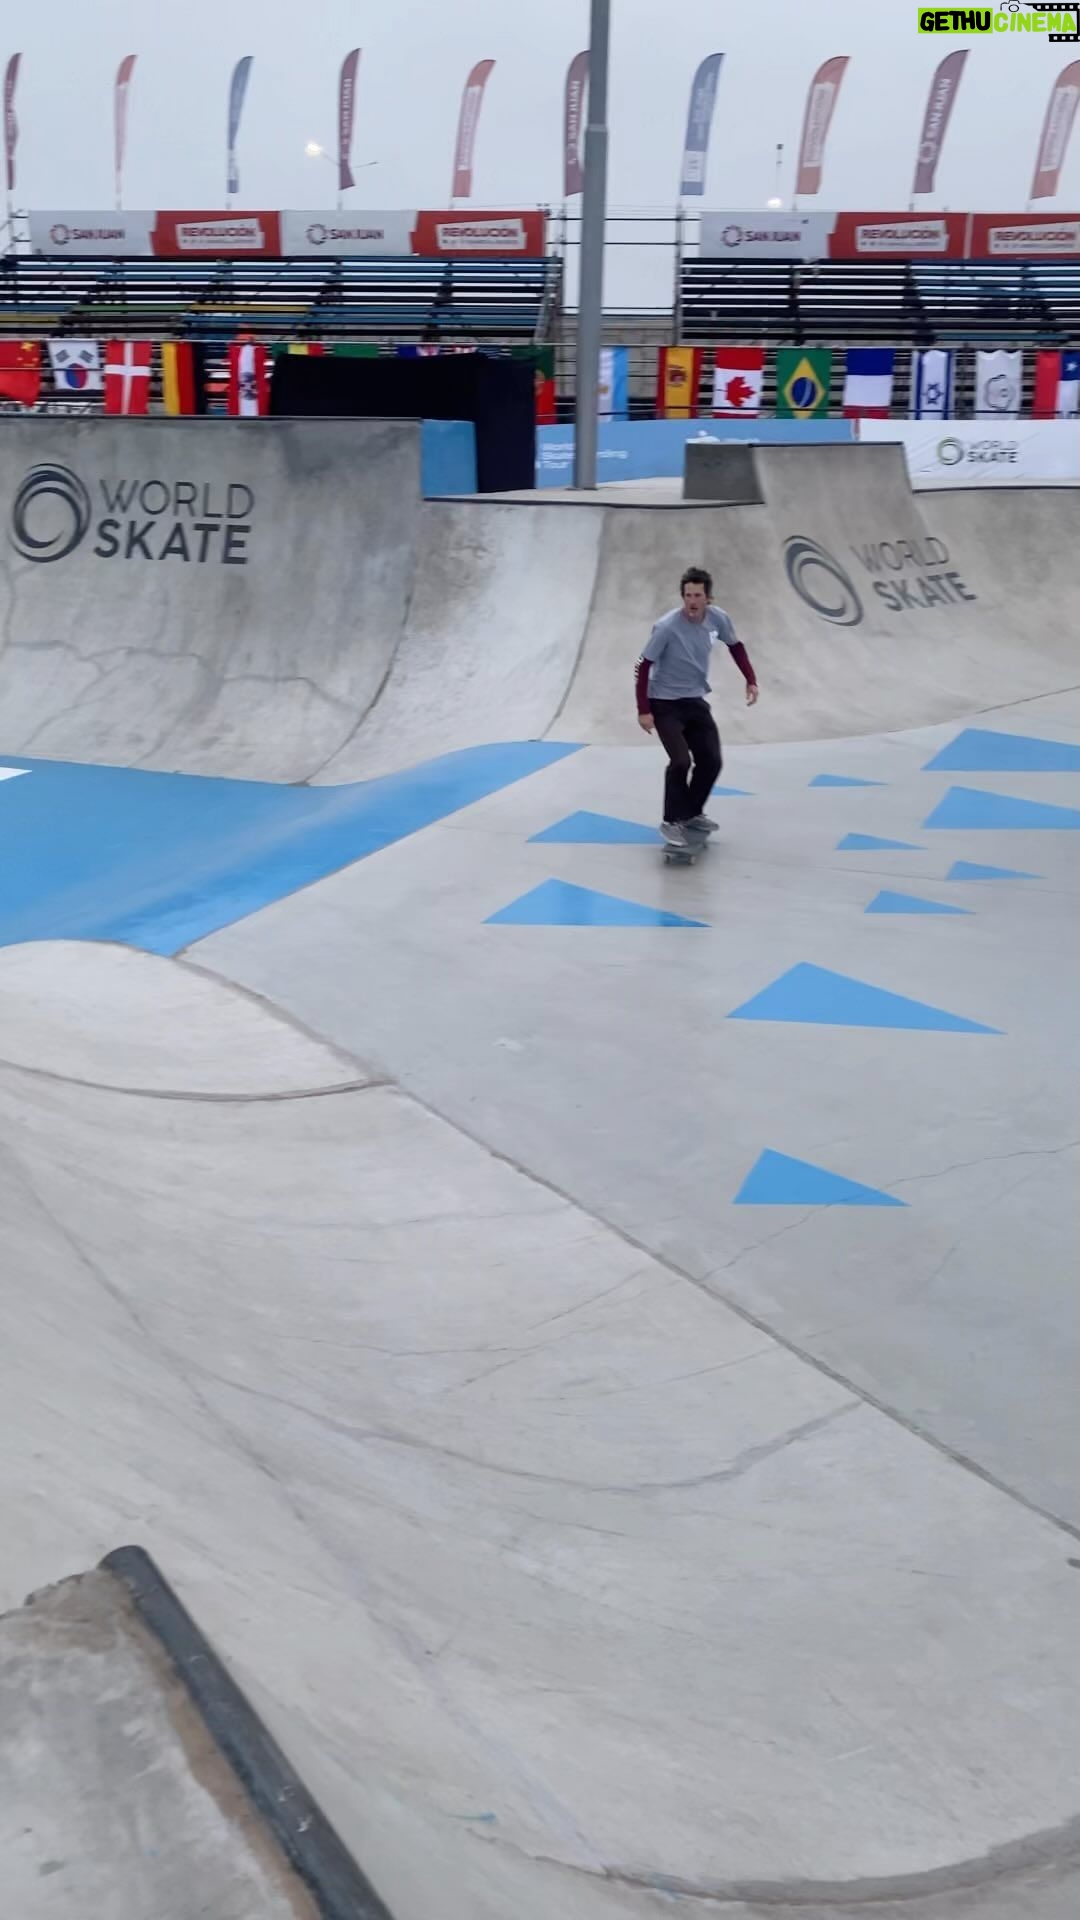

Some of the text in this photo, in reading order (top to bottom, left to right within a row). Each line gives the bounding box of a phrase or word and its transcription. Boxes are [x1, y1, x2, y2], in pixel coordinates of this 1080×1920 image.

[965, 440, 1019, 450] WORLD
[967, 451, 1018, 463] SKATE
[99, 479, 255, 519] WORLD
[93, 518, 252, 565] SKATE
[850, 536, 949, 574] WORLD
[872, 571, 978, 612] SKATE
